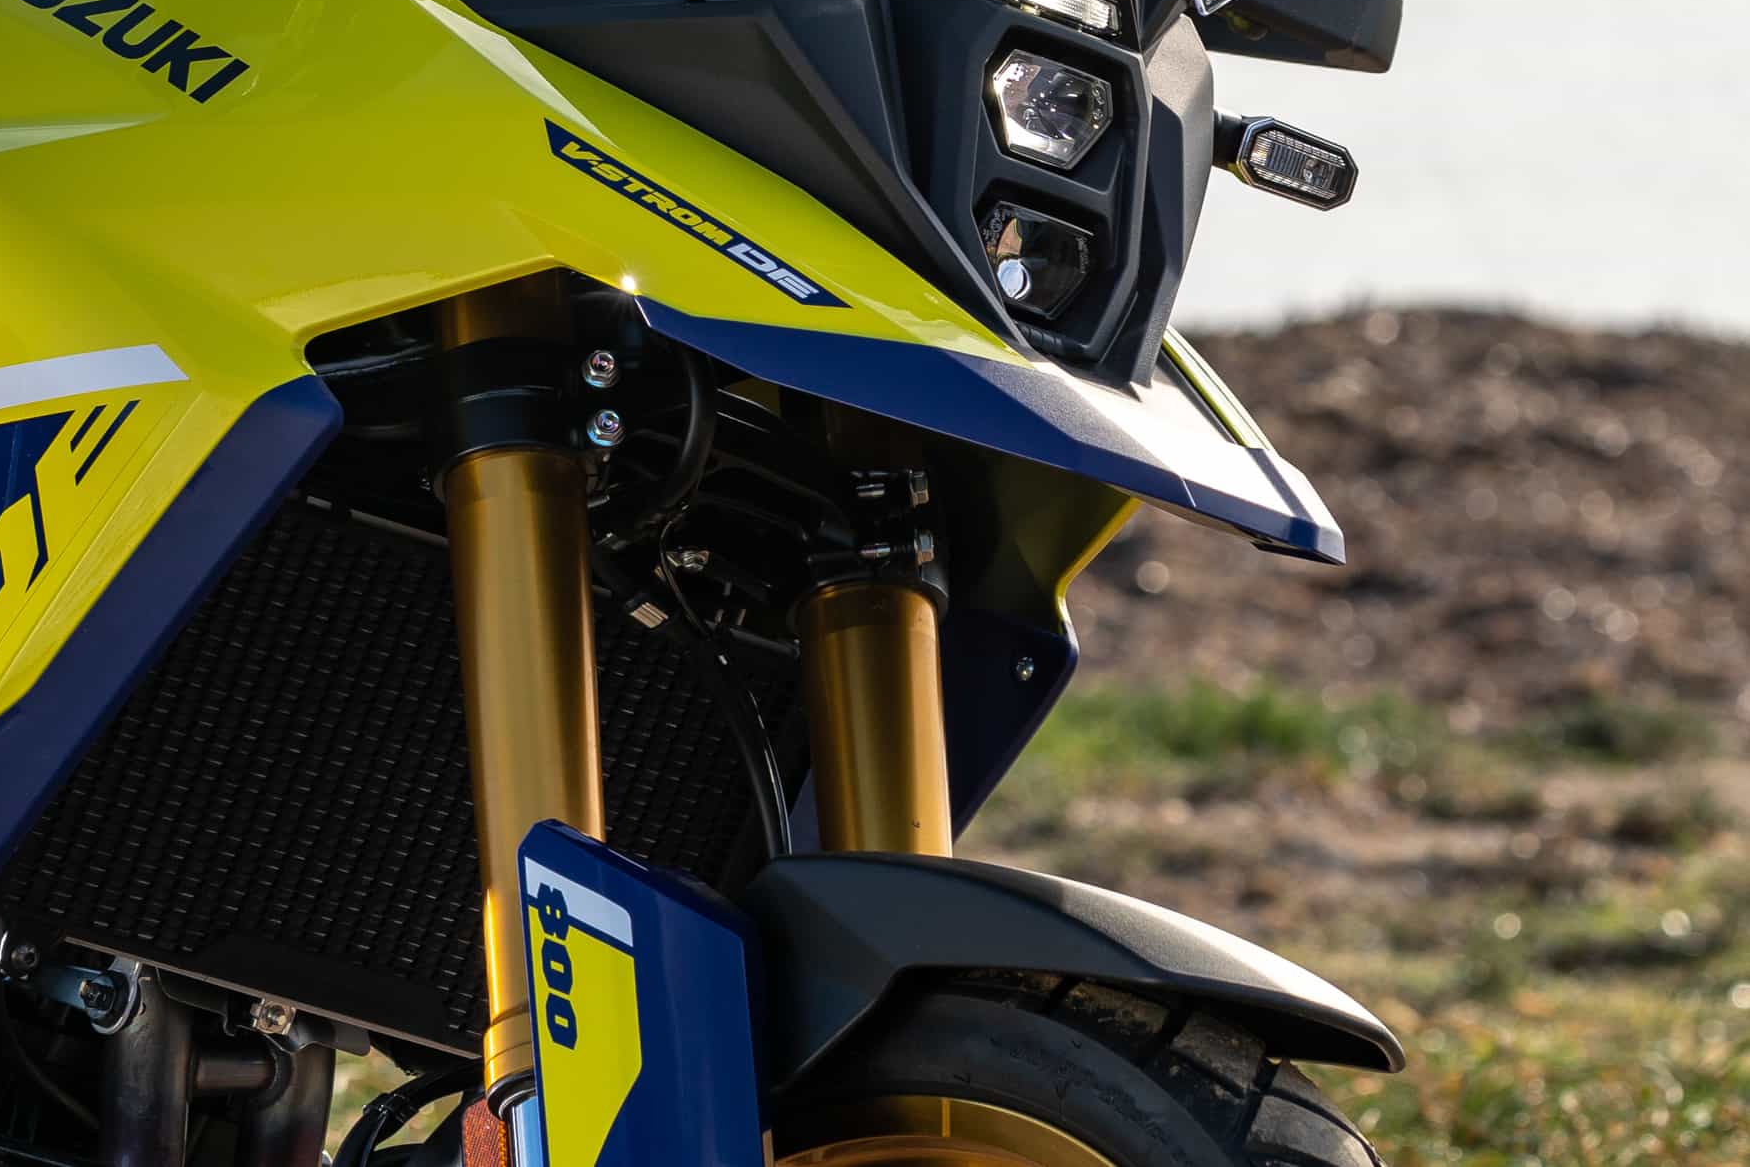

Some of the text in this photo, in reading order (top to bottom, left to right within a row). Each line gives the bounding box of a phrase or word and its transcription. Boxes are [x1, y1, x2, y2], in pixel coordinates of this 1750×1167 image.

[560, 141, 820, 299] V-STROM DE
[537, 882, 578, 1051] 800
